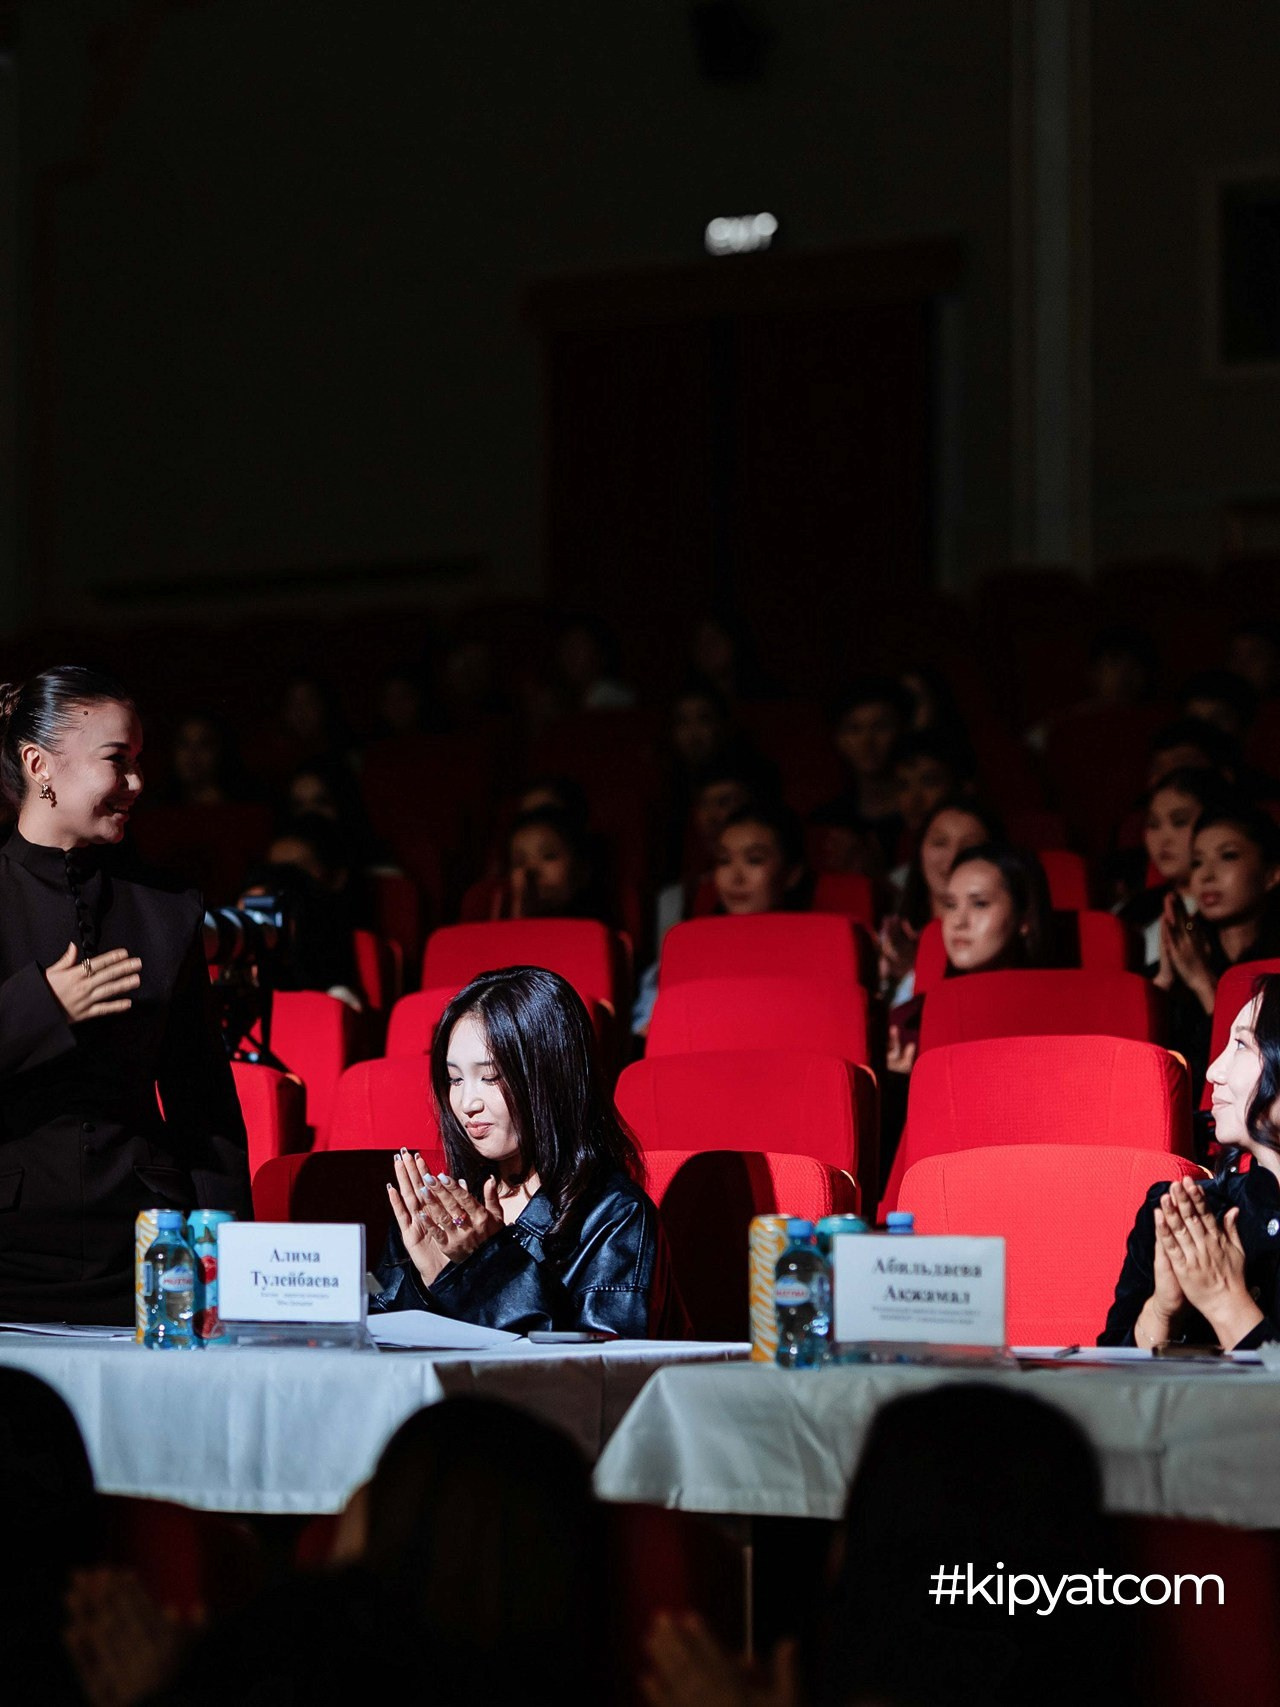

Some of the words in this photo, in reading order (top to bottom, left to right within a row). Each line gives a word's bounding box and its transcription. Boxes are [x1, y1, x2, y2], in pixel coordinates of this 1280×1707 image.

[270, 1248, 321, 1263] Алима
[872, 1256, 982, 1278] Абильдаева
[251, 1271, 339, 1290] Тулейбаева
